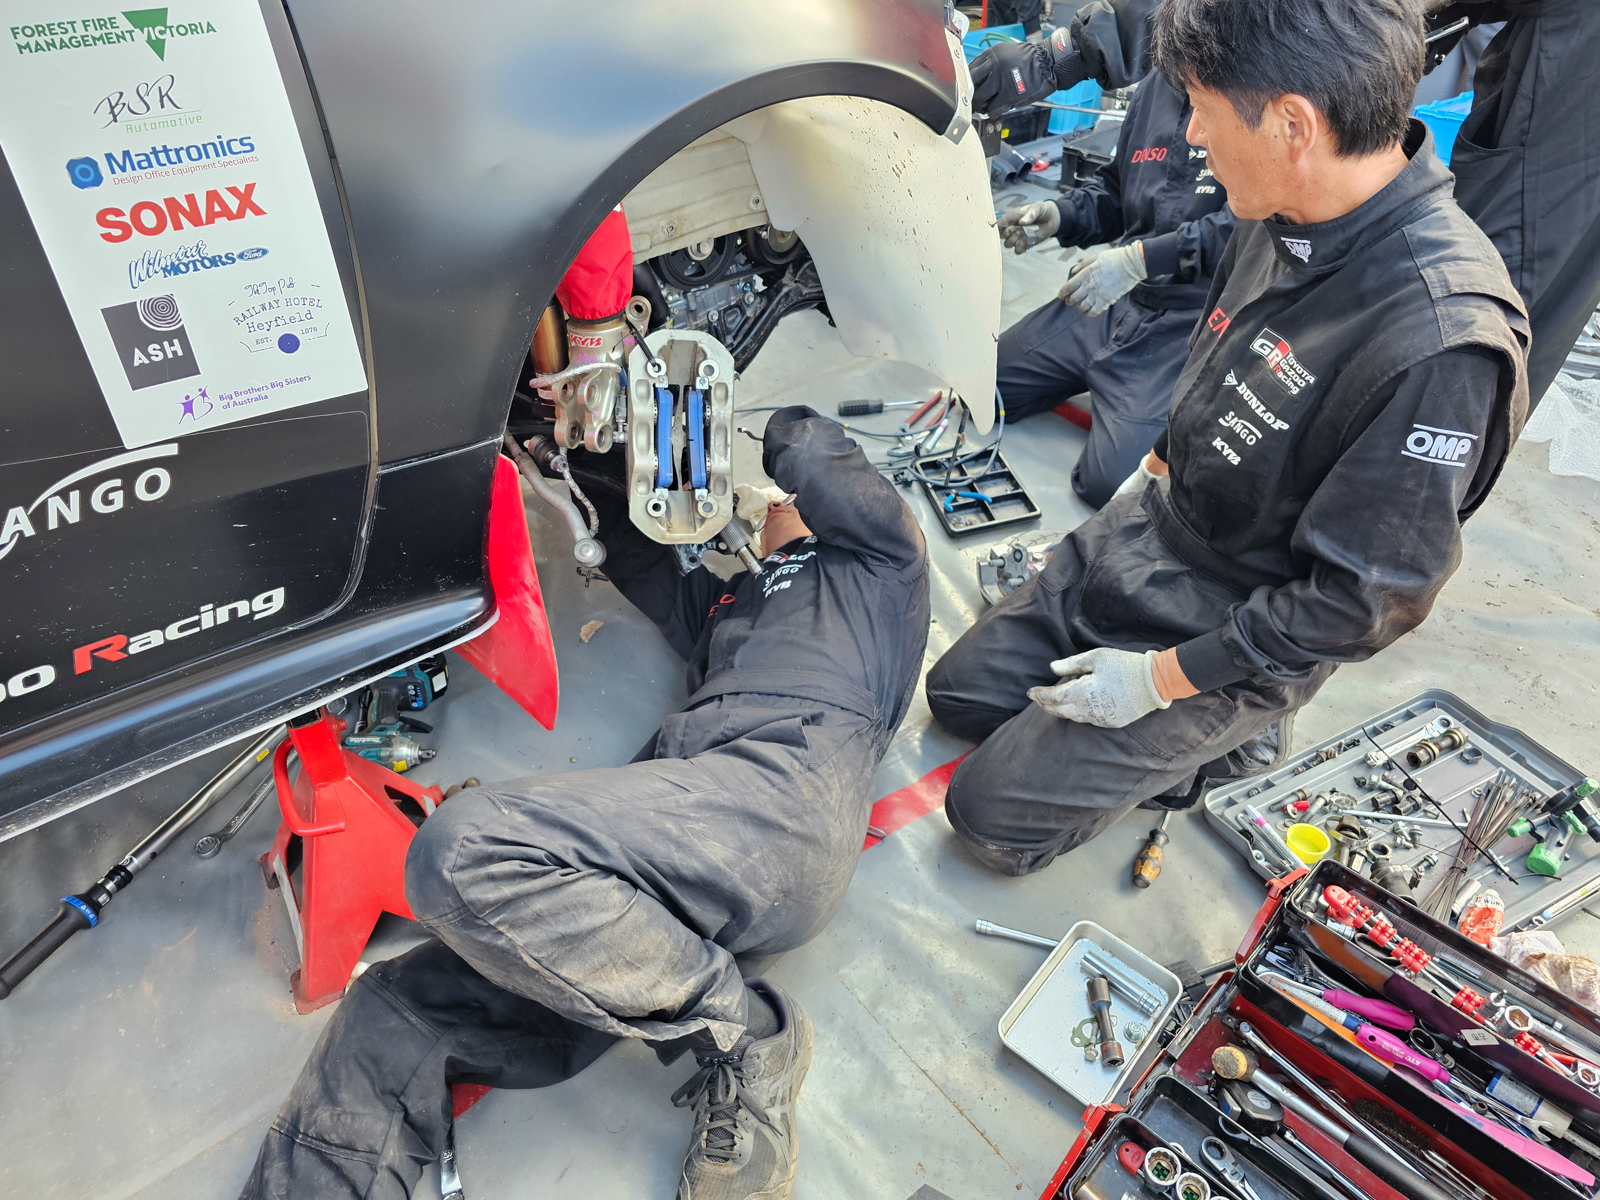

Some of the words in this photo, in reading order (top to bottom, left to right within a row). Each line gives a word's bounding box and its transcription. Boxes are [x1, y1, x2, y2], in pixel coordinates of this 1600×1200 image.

[10, 20, 77, 40] FOREST
[81, 16, 120, 32] FIRE
[15, 29, 136, 55] MANAGEMENT
[136, 21, 218, 42] VICTORIA
[93, 74, 184, 130] BSR
[125, 115, 203, 134] Automotive
[104, 135, 256, 175] Mattronics
[112, 173, 143, 186] Design
[144, 169, 170, 180] Office
[171, 162, 217, 176] Equipment
[217, 155, 260, 169] Specialists
[1195, 185, 1216, 194] KYB
[95, 182, 268, 243] SONAX
[241, 248, 264, 260] Ford
[1284, 240, 1312, 260] OMP
[161, 252, 237, 278] MOTORS
[258, 281, 277, 296] Top
[277, 276, 296, 295] Pub
[233, 299, 281, 326] RAILWAY
[284, 297, 323, 308] HOTEL
[246, 309, 314, 333] Heyfield
[133, 338, 184, 367] ASH
[254, 336, 272, 345] EST.
[570, 333, 603, 348] KYB
[1252, 338, 1284, 367] GR
[1273, 365, 1301, 395] Racing
[1279, 359, 1306, 388] GAZOO
[1284, 351, 1316, 384] TOYOTA
[218, 393, 234, 402] Big
[234, 384, 270, 398] Brothers
[270, 379, 284, 389] Big
[284, 374, 312, 386] Sisters
[222, 401, 232, 410] of
[232, 393, 269, 408] Australia
[1236, 381, 1290, 430] DUNLOP
[1224, 411, 1257, 446] SANGO
[1212, 436, 1242, 466] KYB
[1406, 430, 1472, 461] OMP
[0, 467, 171, 546] ANGO
[765, 567, 800, 587] SANGO
[72, 586, 285, 675] Racing
